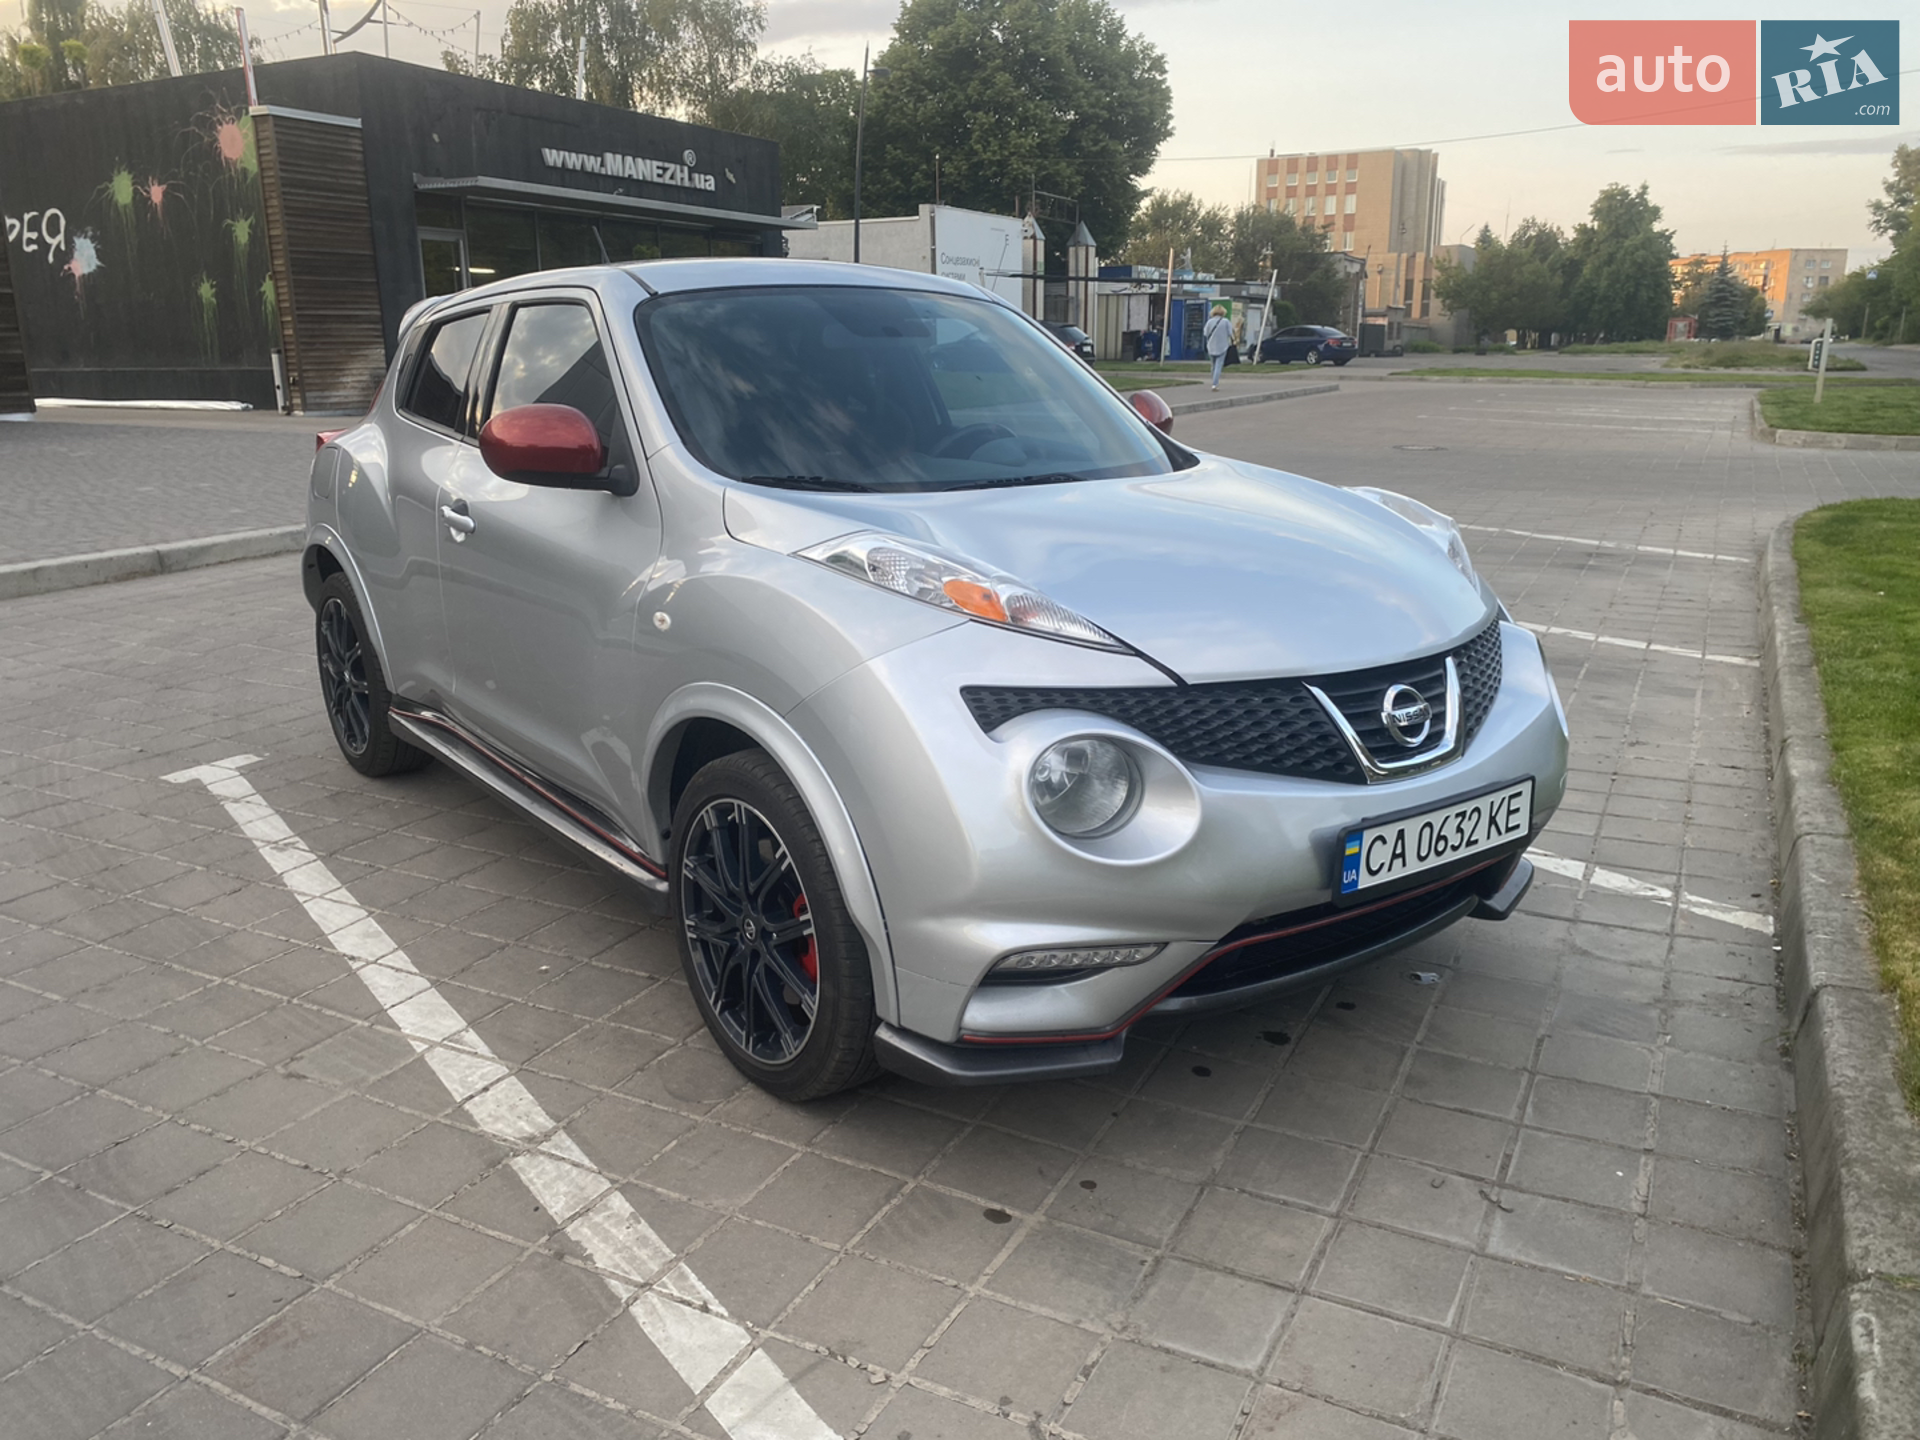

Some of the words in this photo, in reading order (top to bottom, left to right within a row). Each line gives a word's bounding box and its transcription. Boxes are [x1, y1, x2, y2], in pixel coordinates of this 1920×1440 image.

[1365, 828, 1407, 877] CA
[1416, 806, 1482, 862] 0632
[1486, 790, 1523, 841] KE
[1343, 870, 1358, 884] UA
